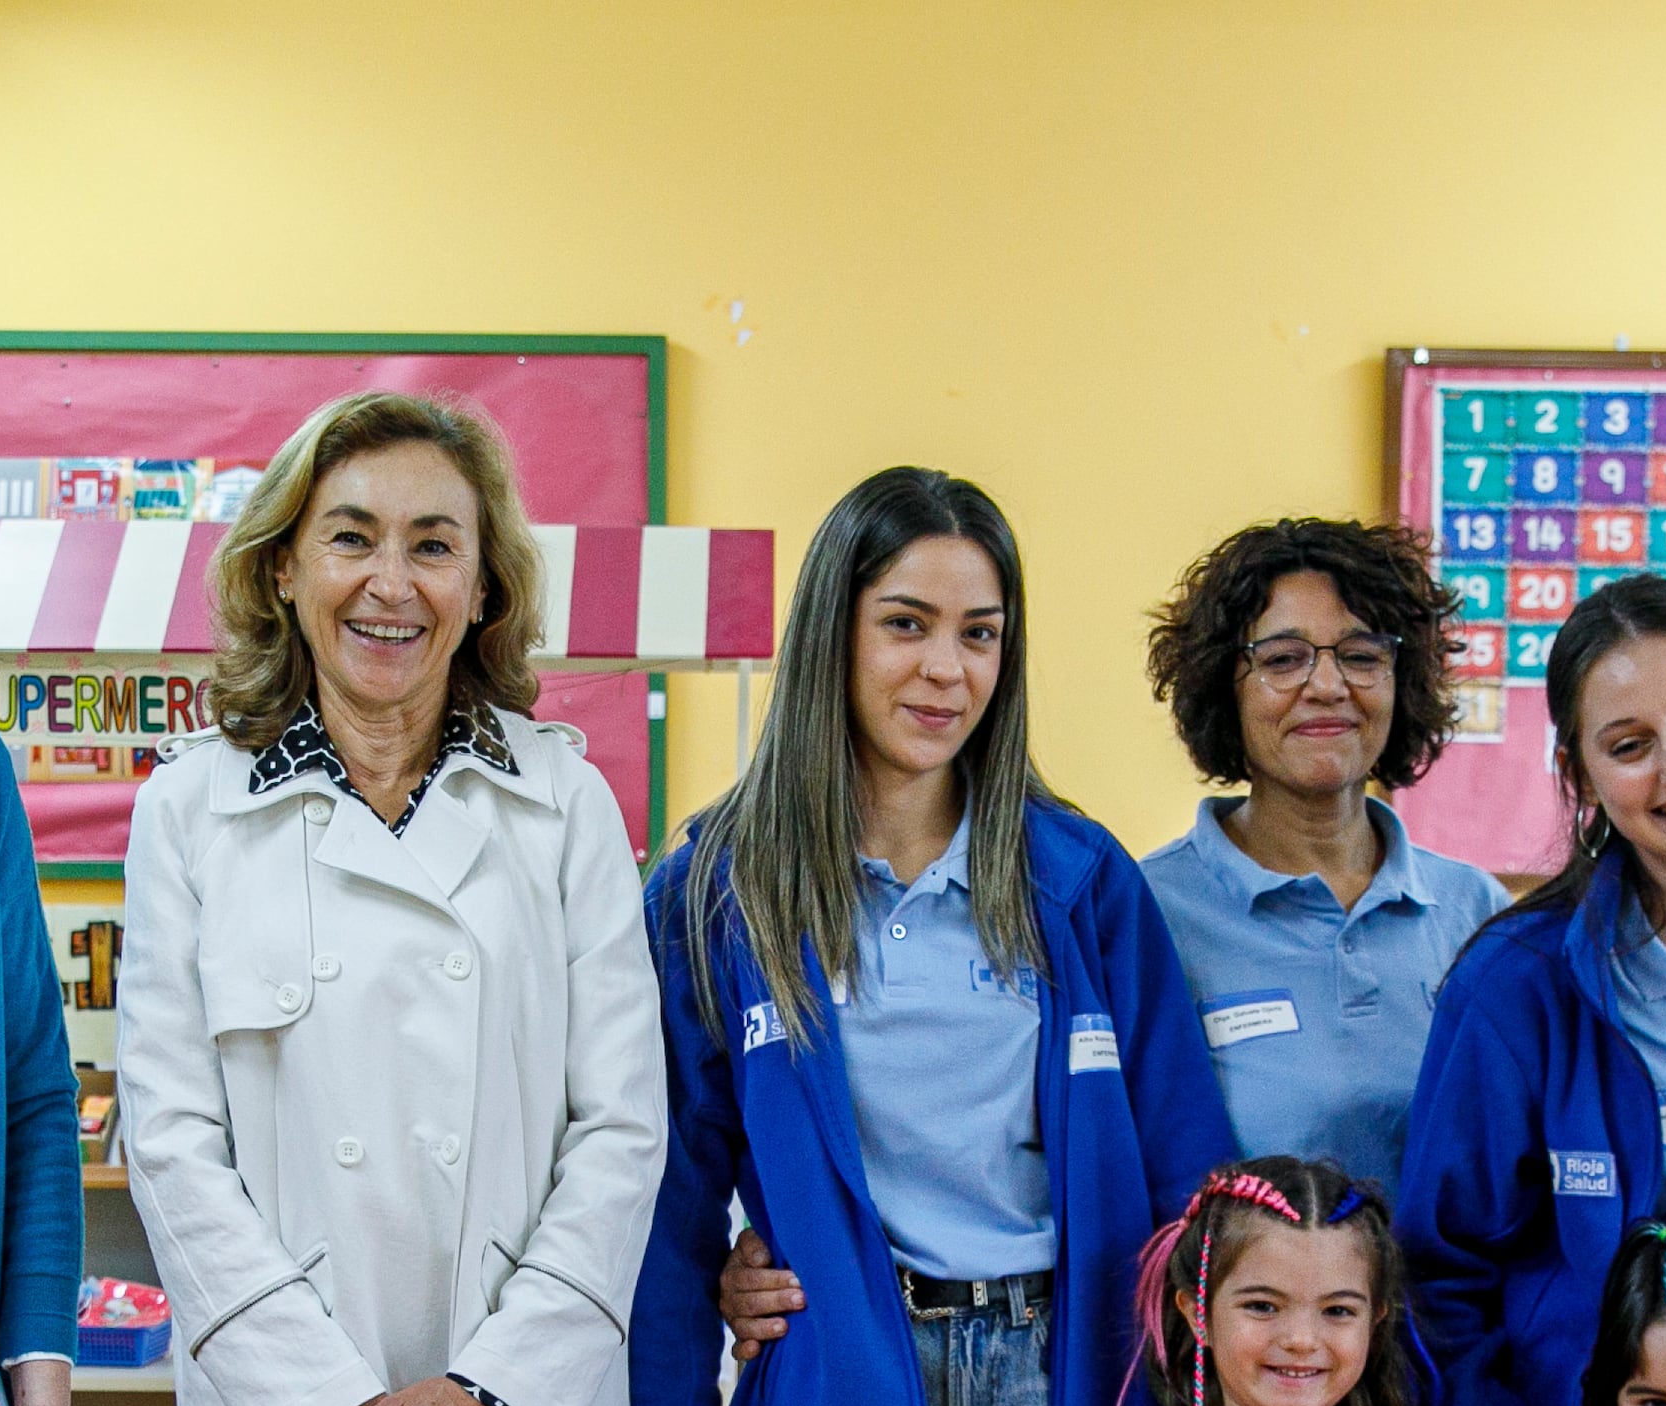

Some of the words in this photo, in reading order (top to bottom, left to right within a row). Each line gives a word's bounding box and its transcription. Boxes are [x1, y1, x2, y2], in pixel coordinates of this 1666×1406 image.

[1470, 401, 1482, 431] 1
[1536, 401, 1557, 432] 2
[1605, 401, 1628, 434] 3
[1466, 459, 1485, 489] 7
[1534, 458, 1556, 491] 8
[1600, 459, 1625, 494] 9
[1456, 516, 1494, 549] 13
[1524, 518, 1564, 551] 14
[1592, 516, 1633, 552] 15
[1519, 573, 1567, 610] 20
[1564, 1174, 1608, 1191] Salud
[1566, 1158, 1605, 1176] Rioja
